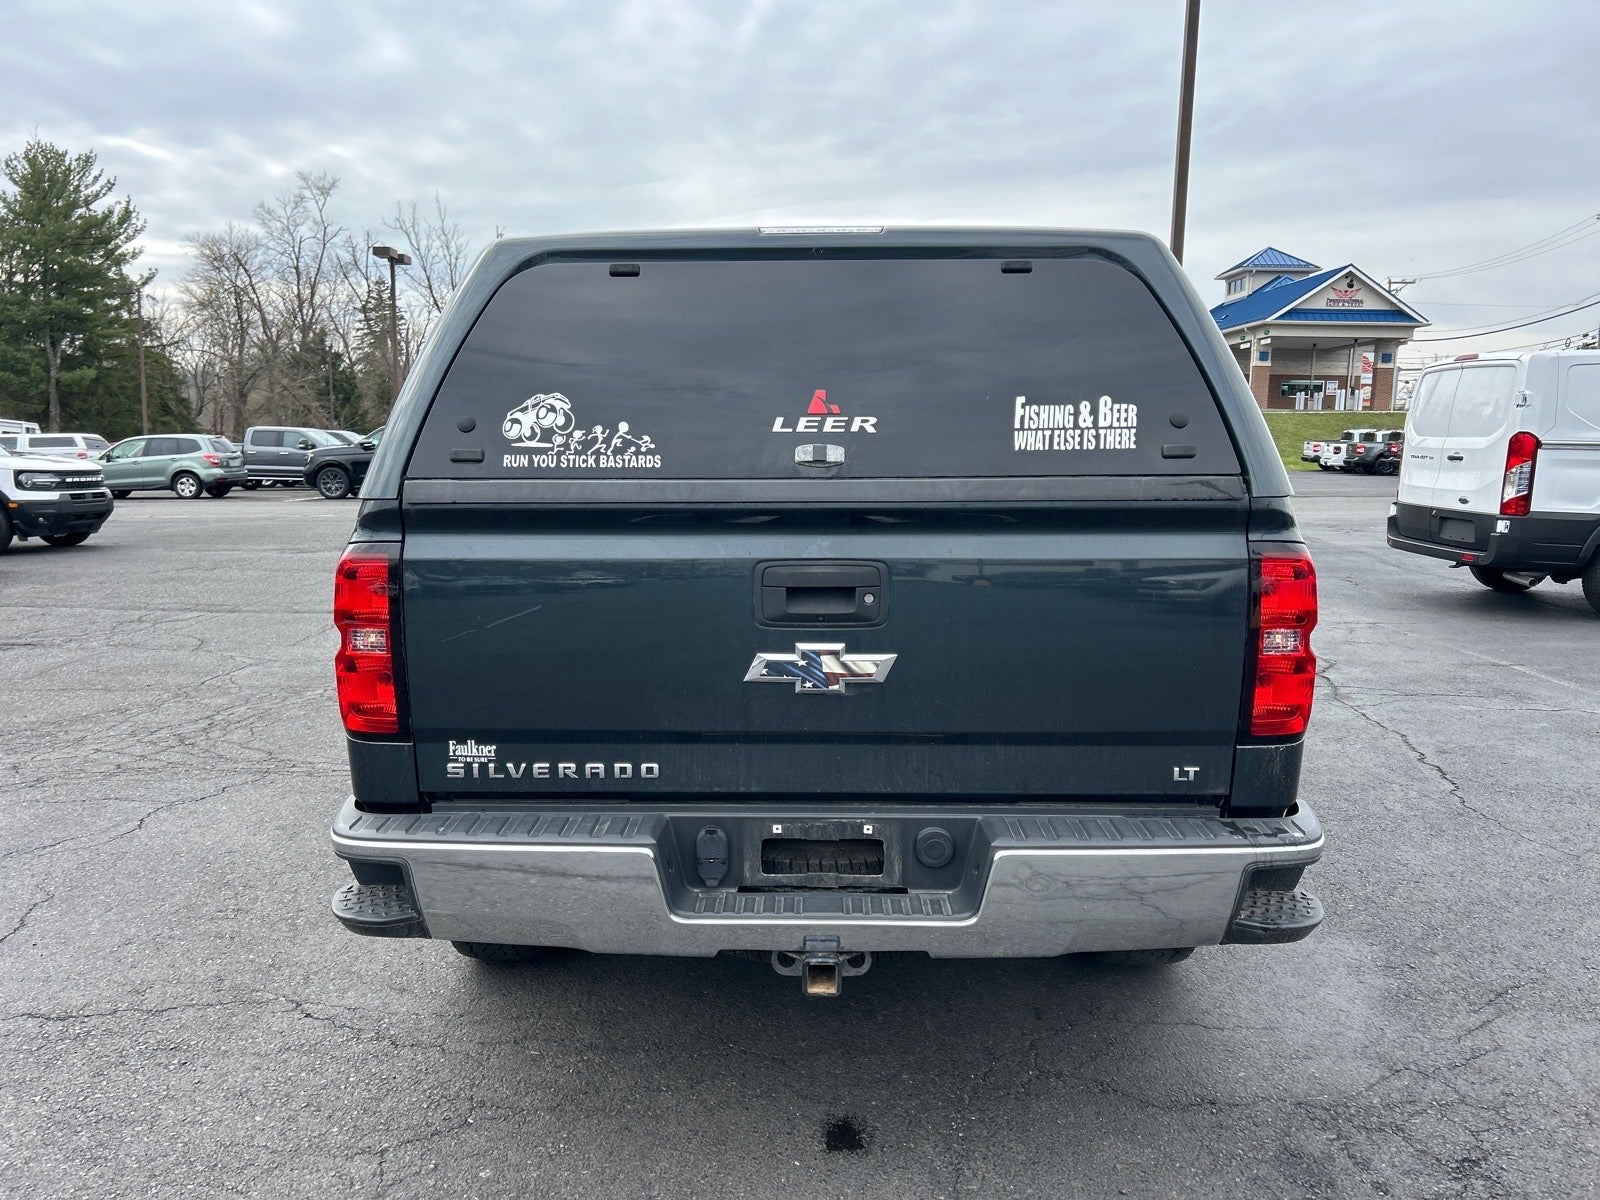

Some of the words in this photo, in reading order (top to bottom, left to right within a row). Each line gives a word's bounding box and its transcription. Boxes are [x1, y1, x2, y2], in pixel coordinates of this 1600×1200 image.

[1014, 396, 1075, 429] FISHING
[1078, 400, 1094, 429] &
[1098, 395, 1138, 428] BEER
[772, 416, 878, 433] LEER
[1014, 429, 1052, 451] WHAT
[1053, 429, 1081, 451] ELSE
[1083, 428, 1097, 450] IS
[1098, 428, 1137, 449] THERE
[503, 454, 529, 468] RUN
[532, 454, 557, 468] YOU
[560, 454, 597, 468] STICK
[599, 454, 662, 468] BASTARDS
[448, 739, 497, 757] Faulkner
[446, 762, 660, 779] SILVERADO
[1173, 766, 1200, 781] LT
